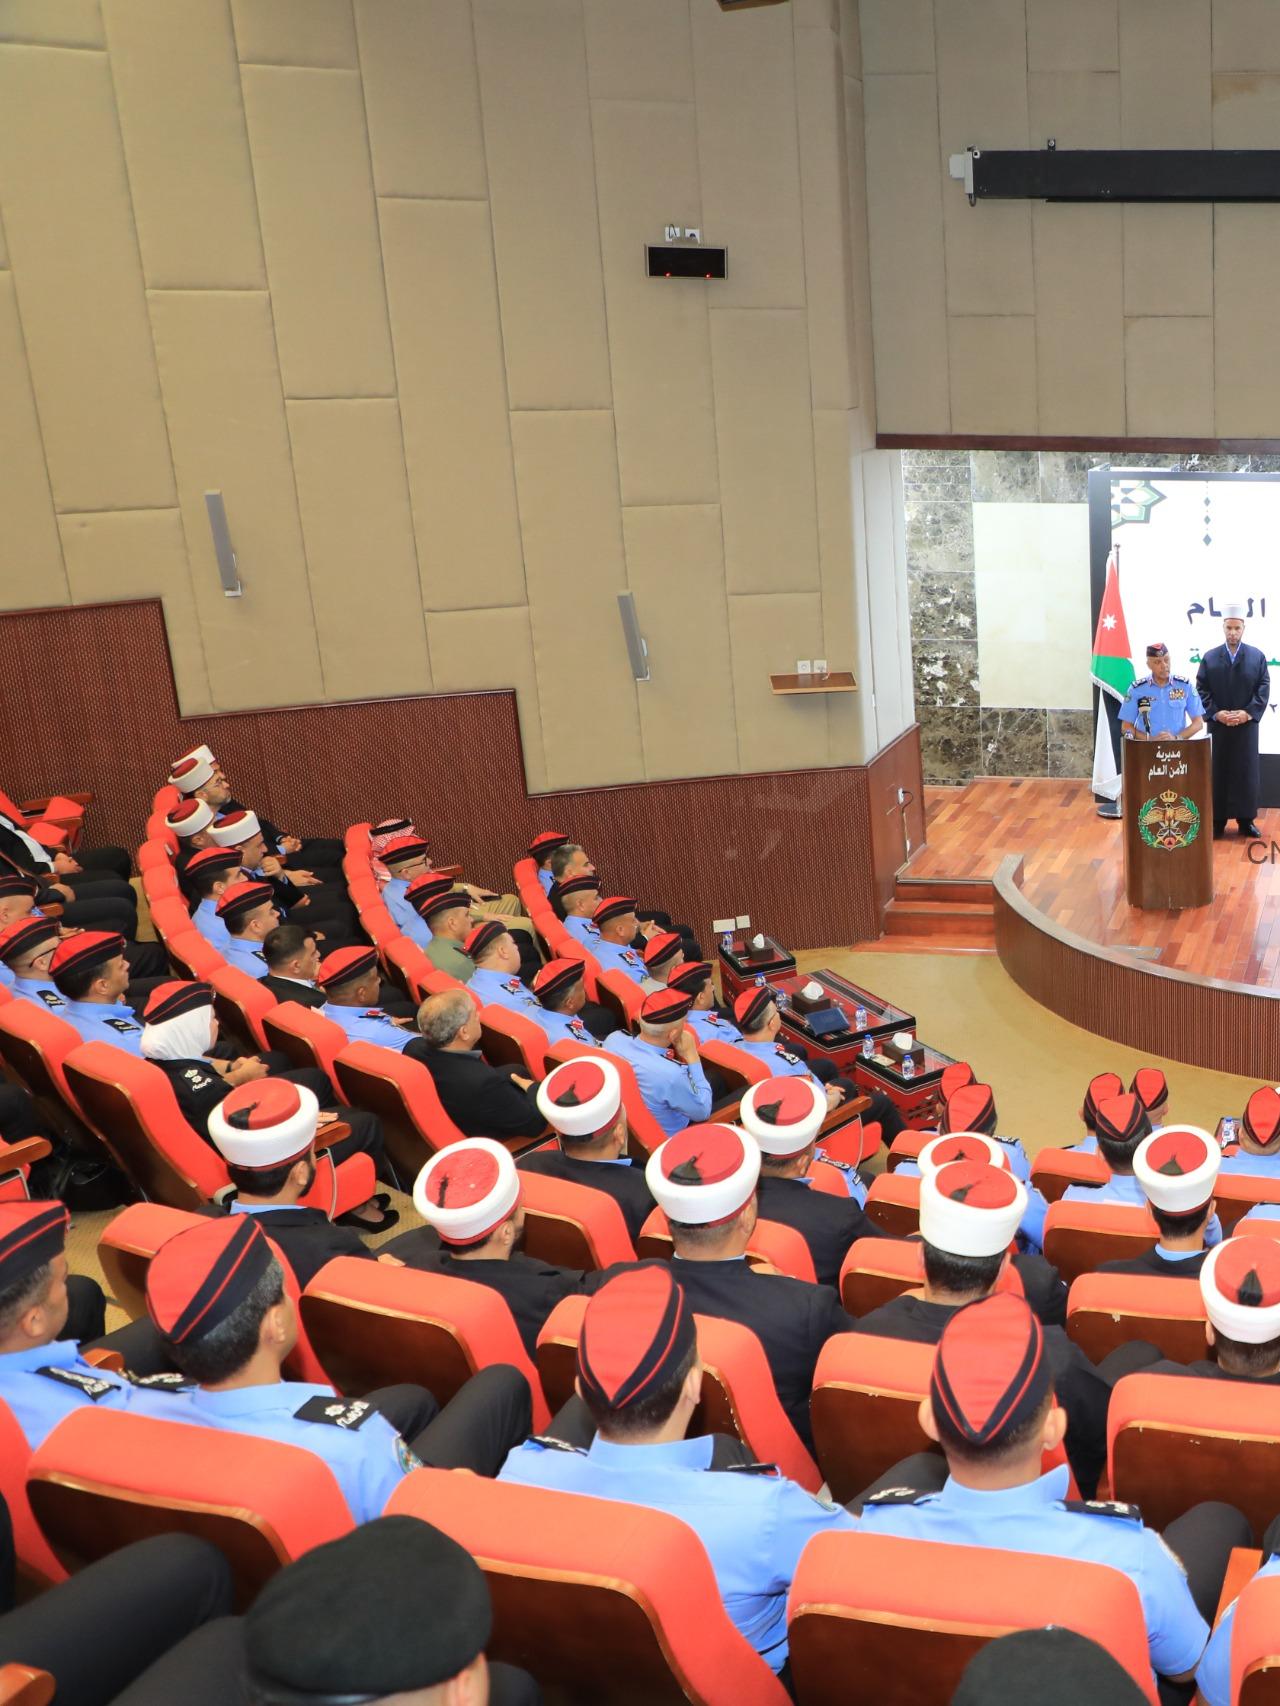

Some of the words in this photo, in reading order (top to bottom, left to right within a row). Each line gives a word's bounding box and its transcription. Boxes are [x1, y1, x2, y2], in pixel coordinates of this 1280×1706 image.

[1187, 597, 1265, 624] الام
[1156, 745, 1181, 762] مديرية
[1148, 763, 1167, 782] العام
[1169, 760, 1188, 779] الأمن
